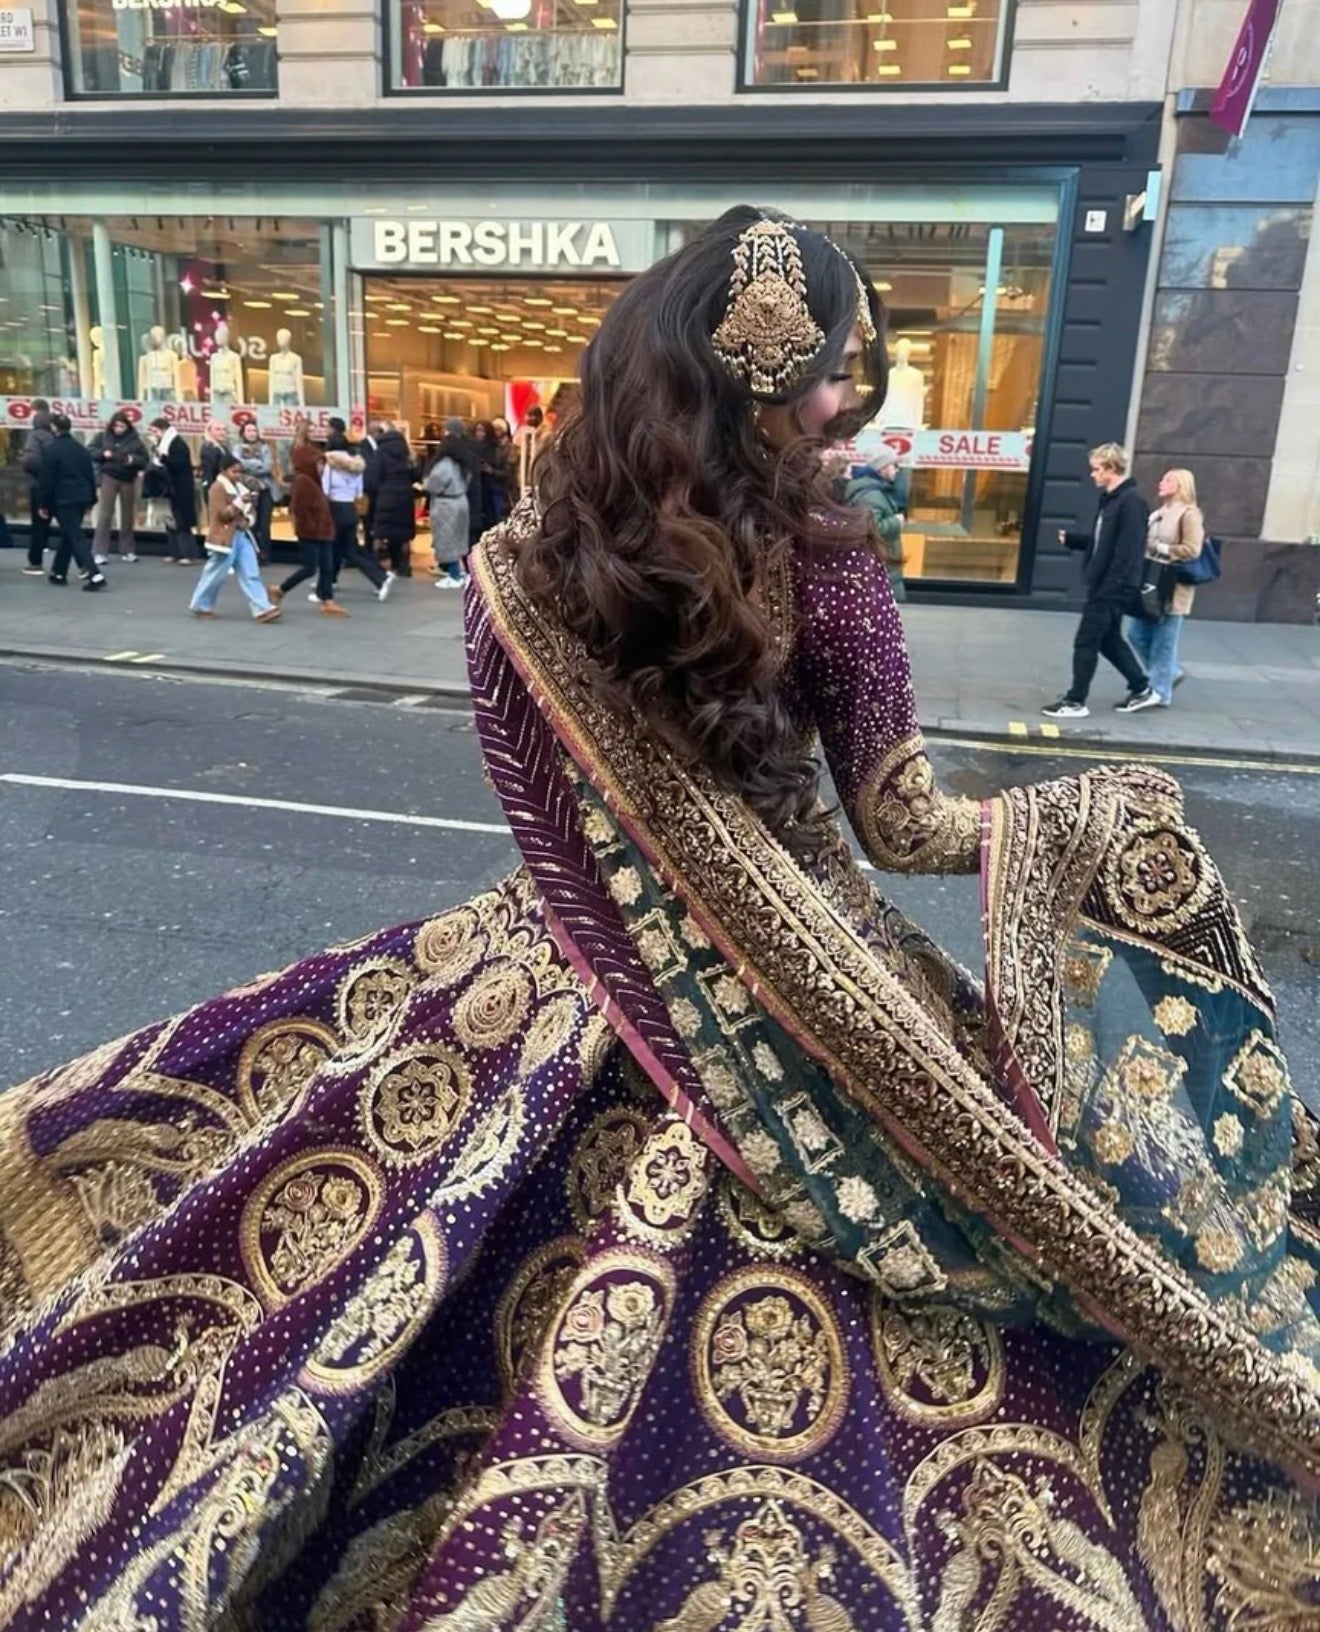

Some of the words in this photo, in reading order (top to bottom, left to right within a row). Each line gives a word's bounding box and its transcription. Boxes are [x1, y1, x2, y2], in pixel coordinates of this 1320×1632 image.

[373, 220, 620, 267] BERSHKA
[51, 400, 98, 419] SALE
[163, 405, 211, 424] SALE
[939, 434, 1002, 455] SALE
